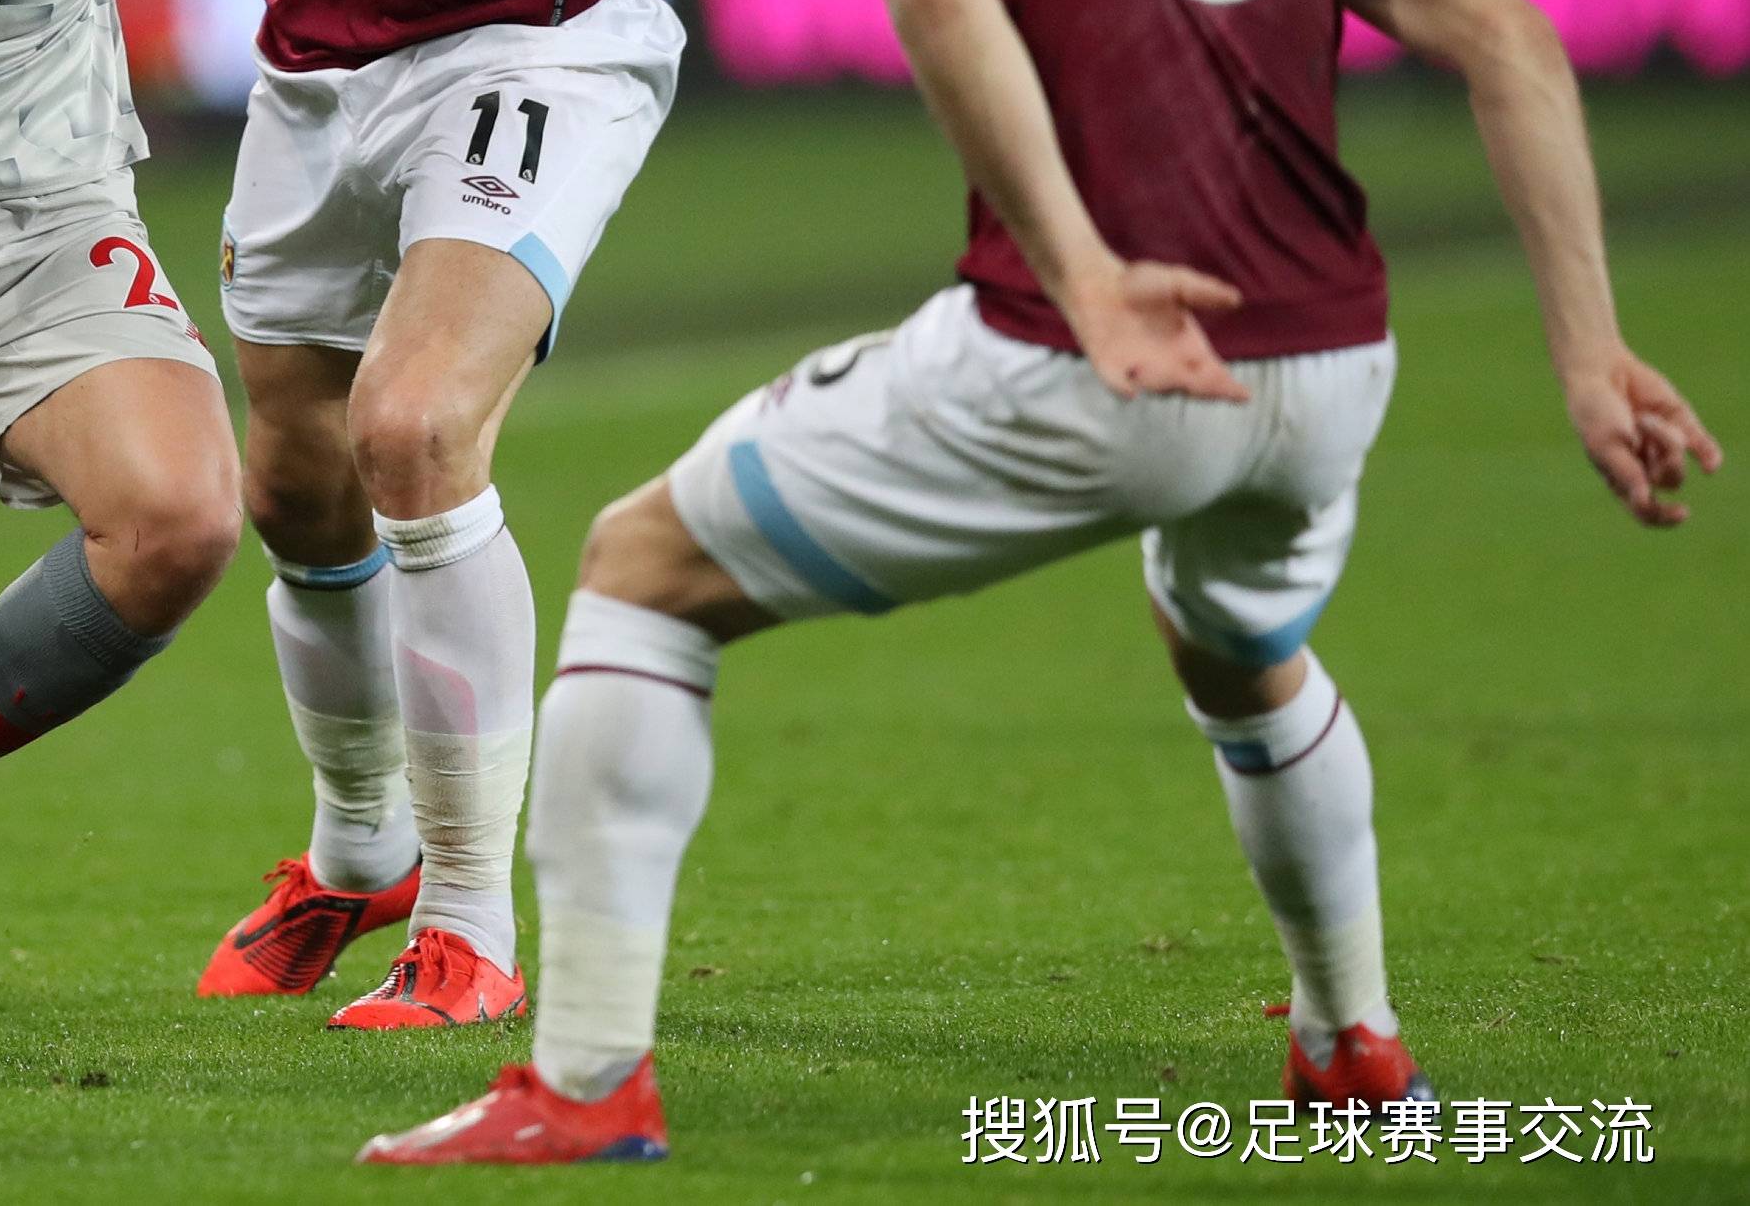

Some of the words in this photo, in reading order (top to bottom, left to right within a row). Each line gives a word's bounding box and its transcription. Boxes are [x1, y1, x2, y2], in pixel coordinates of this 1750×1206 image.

[465, 90, 550, 184] 11
[462, 194, 511, 215] umbro
[89, 236, 180, 311] 2
